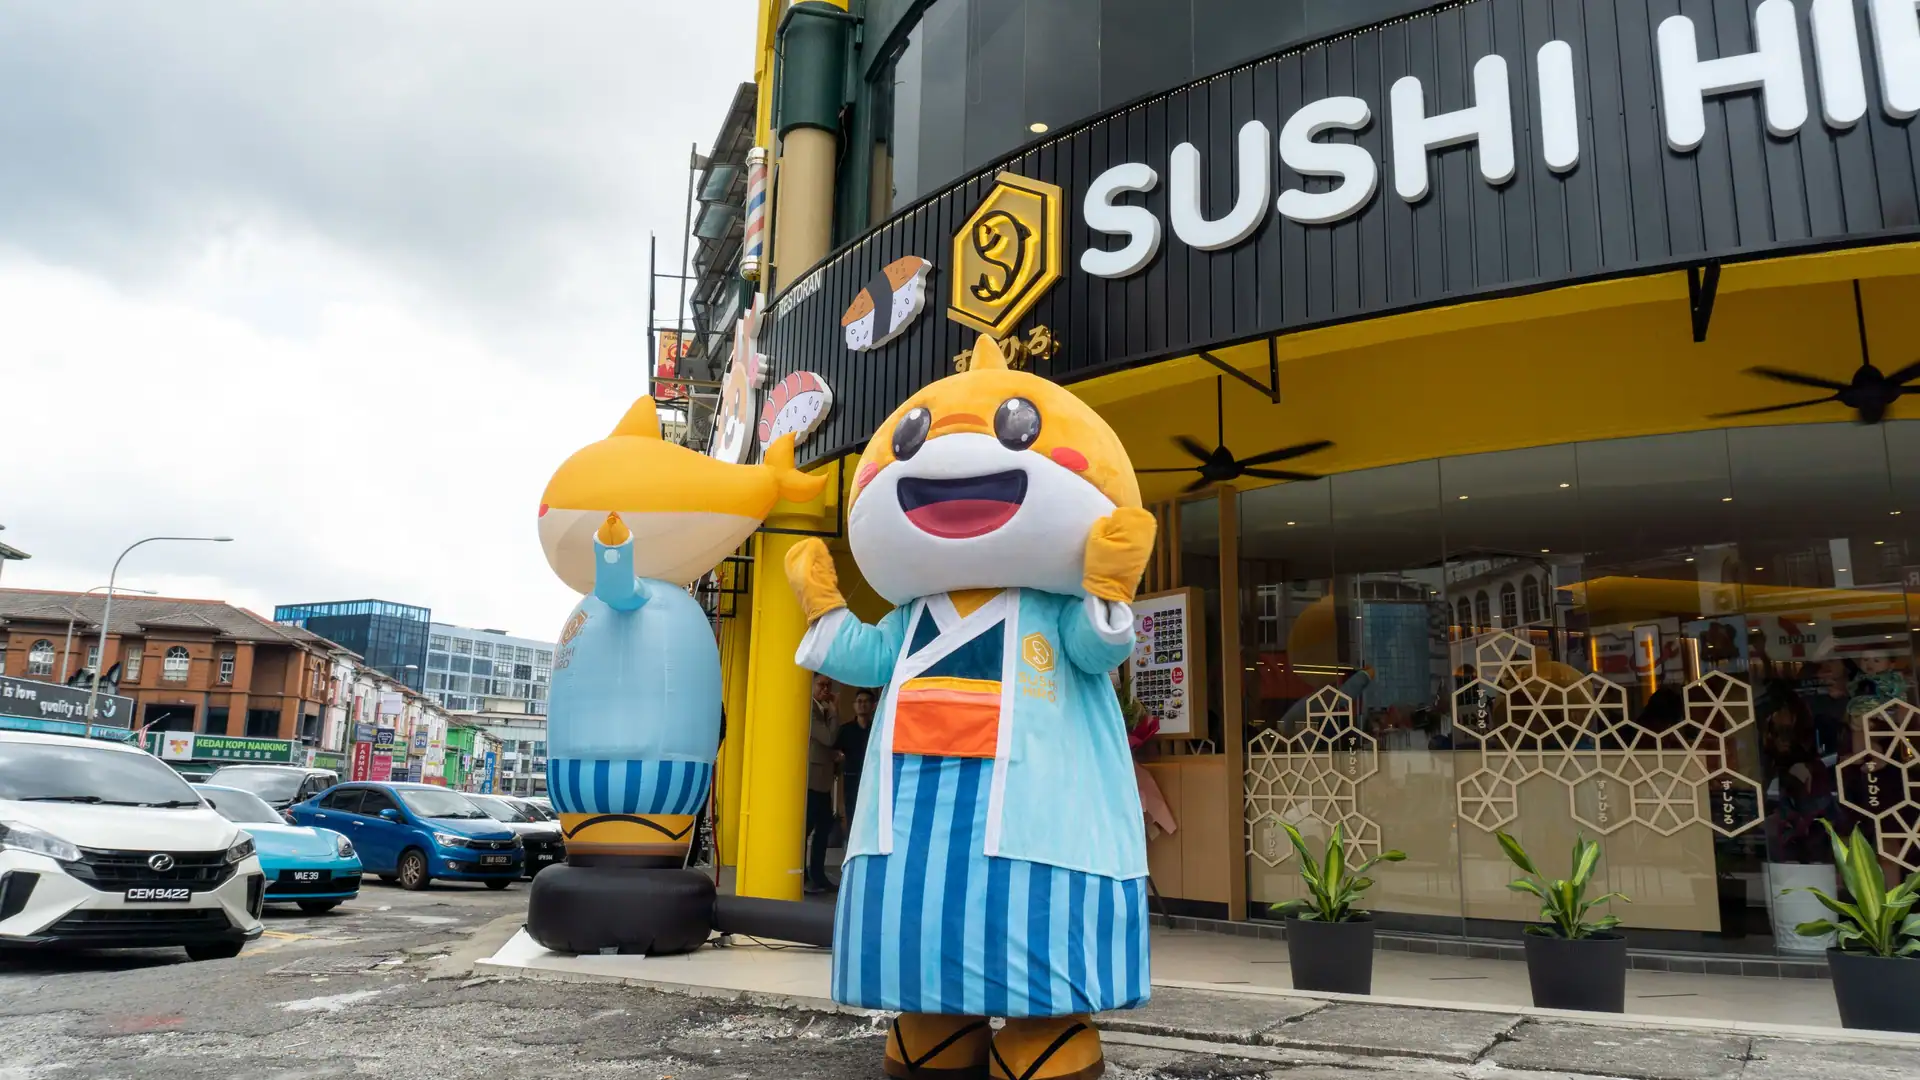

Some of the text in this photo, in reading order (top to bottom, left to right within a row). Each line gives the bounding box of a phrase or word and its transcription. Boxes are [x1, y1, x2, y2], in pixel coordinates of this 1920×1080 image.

[1080, 39, 1580, 279] SUSHI
[778, 269, 822, 321] RESTORAN
[3, 682, 37, 700] is love
[40, 700, 74, 718] quality
[75, 701, 83, 716] is
[1023, 685, 1056, 703] HIRO
[1477, 688, 1488, 729] すしひろ
[196, 738, 288, 752] KEDAI KOPI NANKING
[1348, 737, 1358, 775] すしひろ
[1596, 780, 1609, 822] すしひろ
[1720, 780, 1735, 825] すしひろ
[1865, 761, 1880, 807] すしひろ
